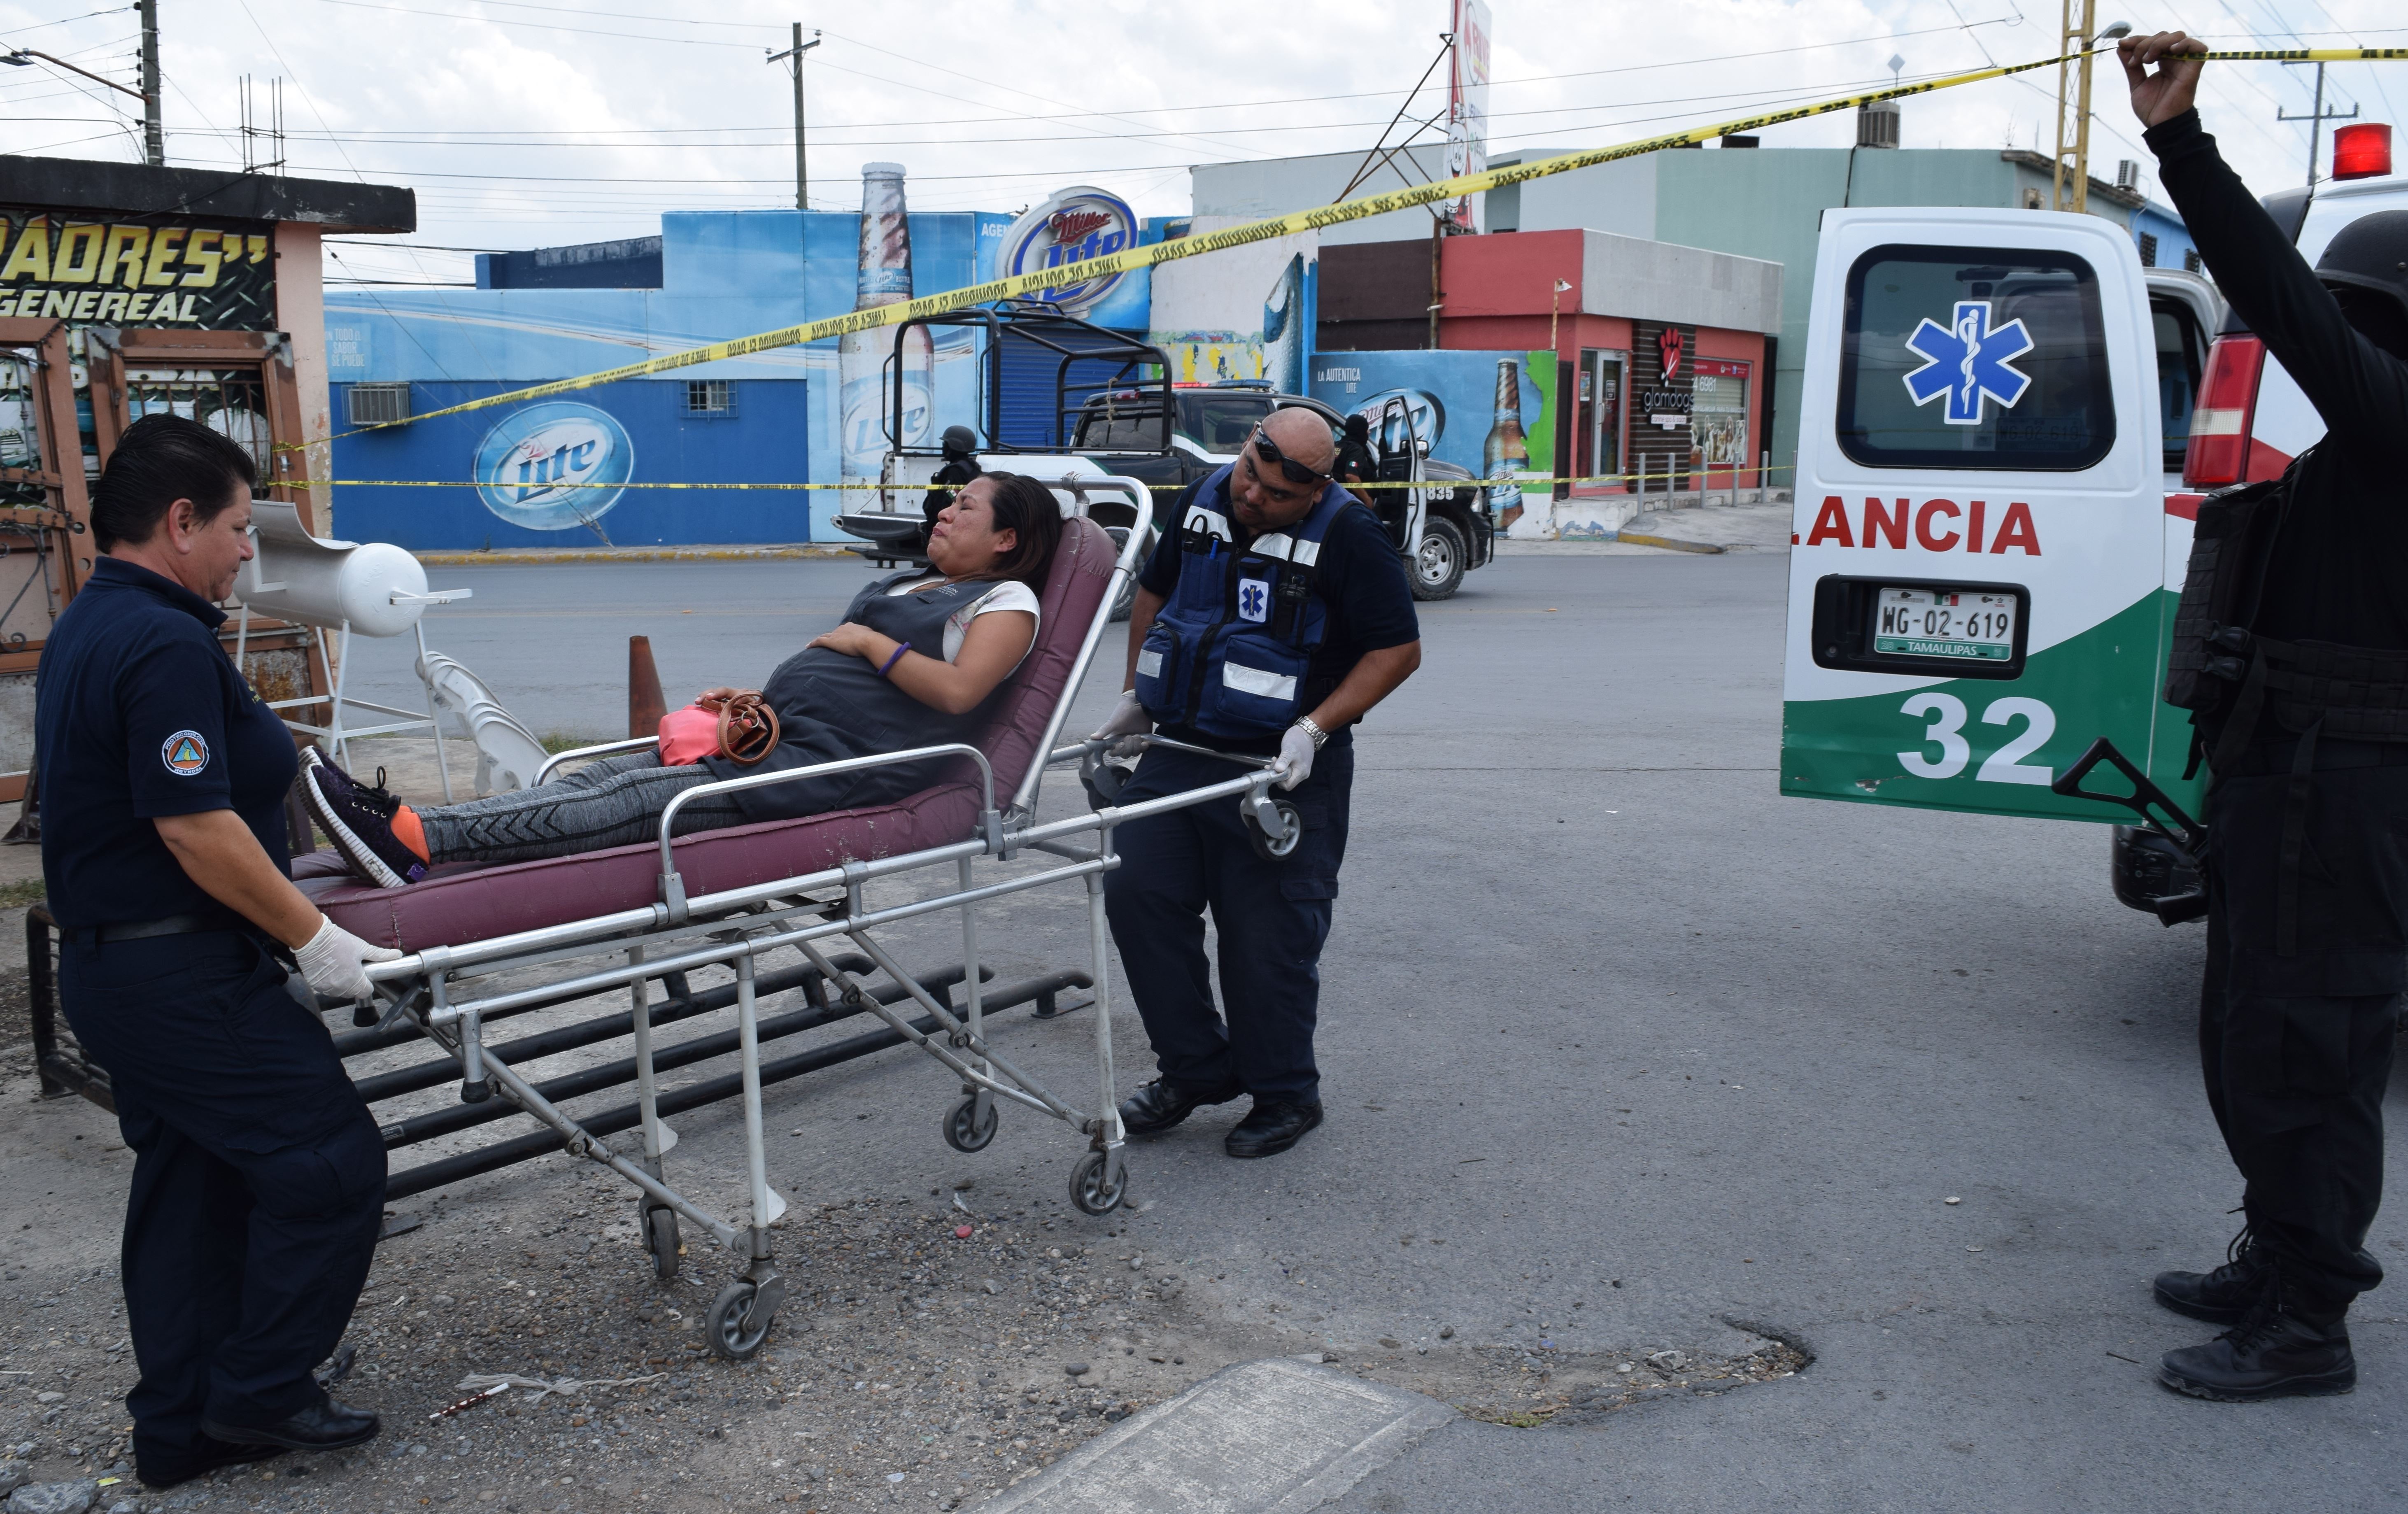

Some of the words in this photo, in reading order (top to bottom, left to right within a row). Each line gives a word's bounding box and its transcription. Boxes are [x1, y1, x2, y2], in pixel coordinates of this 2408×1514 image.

[1052, 212, 1112, 244] Miller
[335, 328, 353, 341] TODO
[333, 341, 356, 354] SABOR
[332, 354, 340, 366] SE
[342, 354, 365, 366] PUEDE
[1318, 371, 1325, 382] LA
[1700, 376, 1716, 392] 6981
[1346, 382, 1357, 394] LITE
[1644, 387, 1694, 413] glamdogs
[515, 439, 596, 504] Lite
[1427, 487, 1454, 500] 835
[1792, 496, 2042, 556] ANCIA
[1882, 606, 2008, 638] WG-02-619
[1907, 641, 1977, 656] TAMAULIPAS
[1897, 692, 2056, 786] 32
